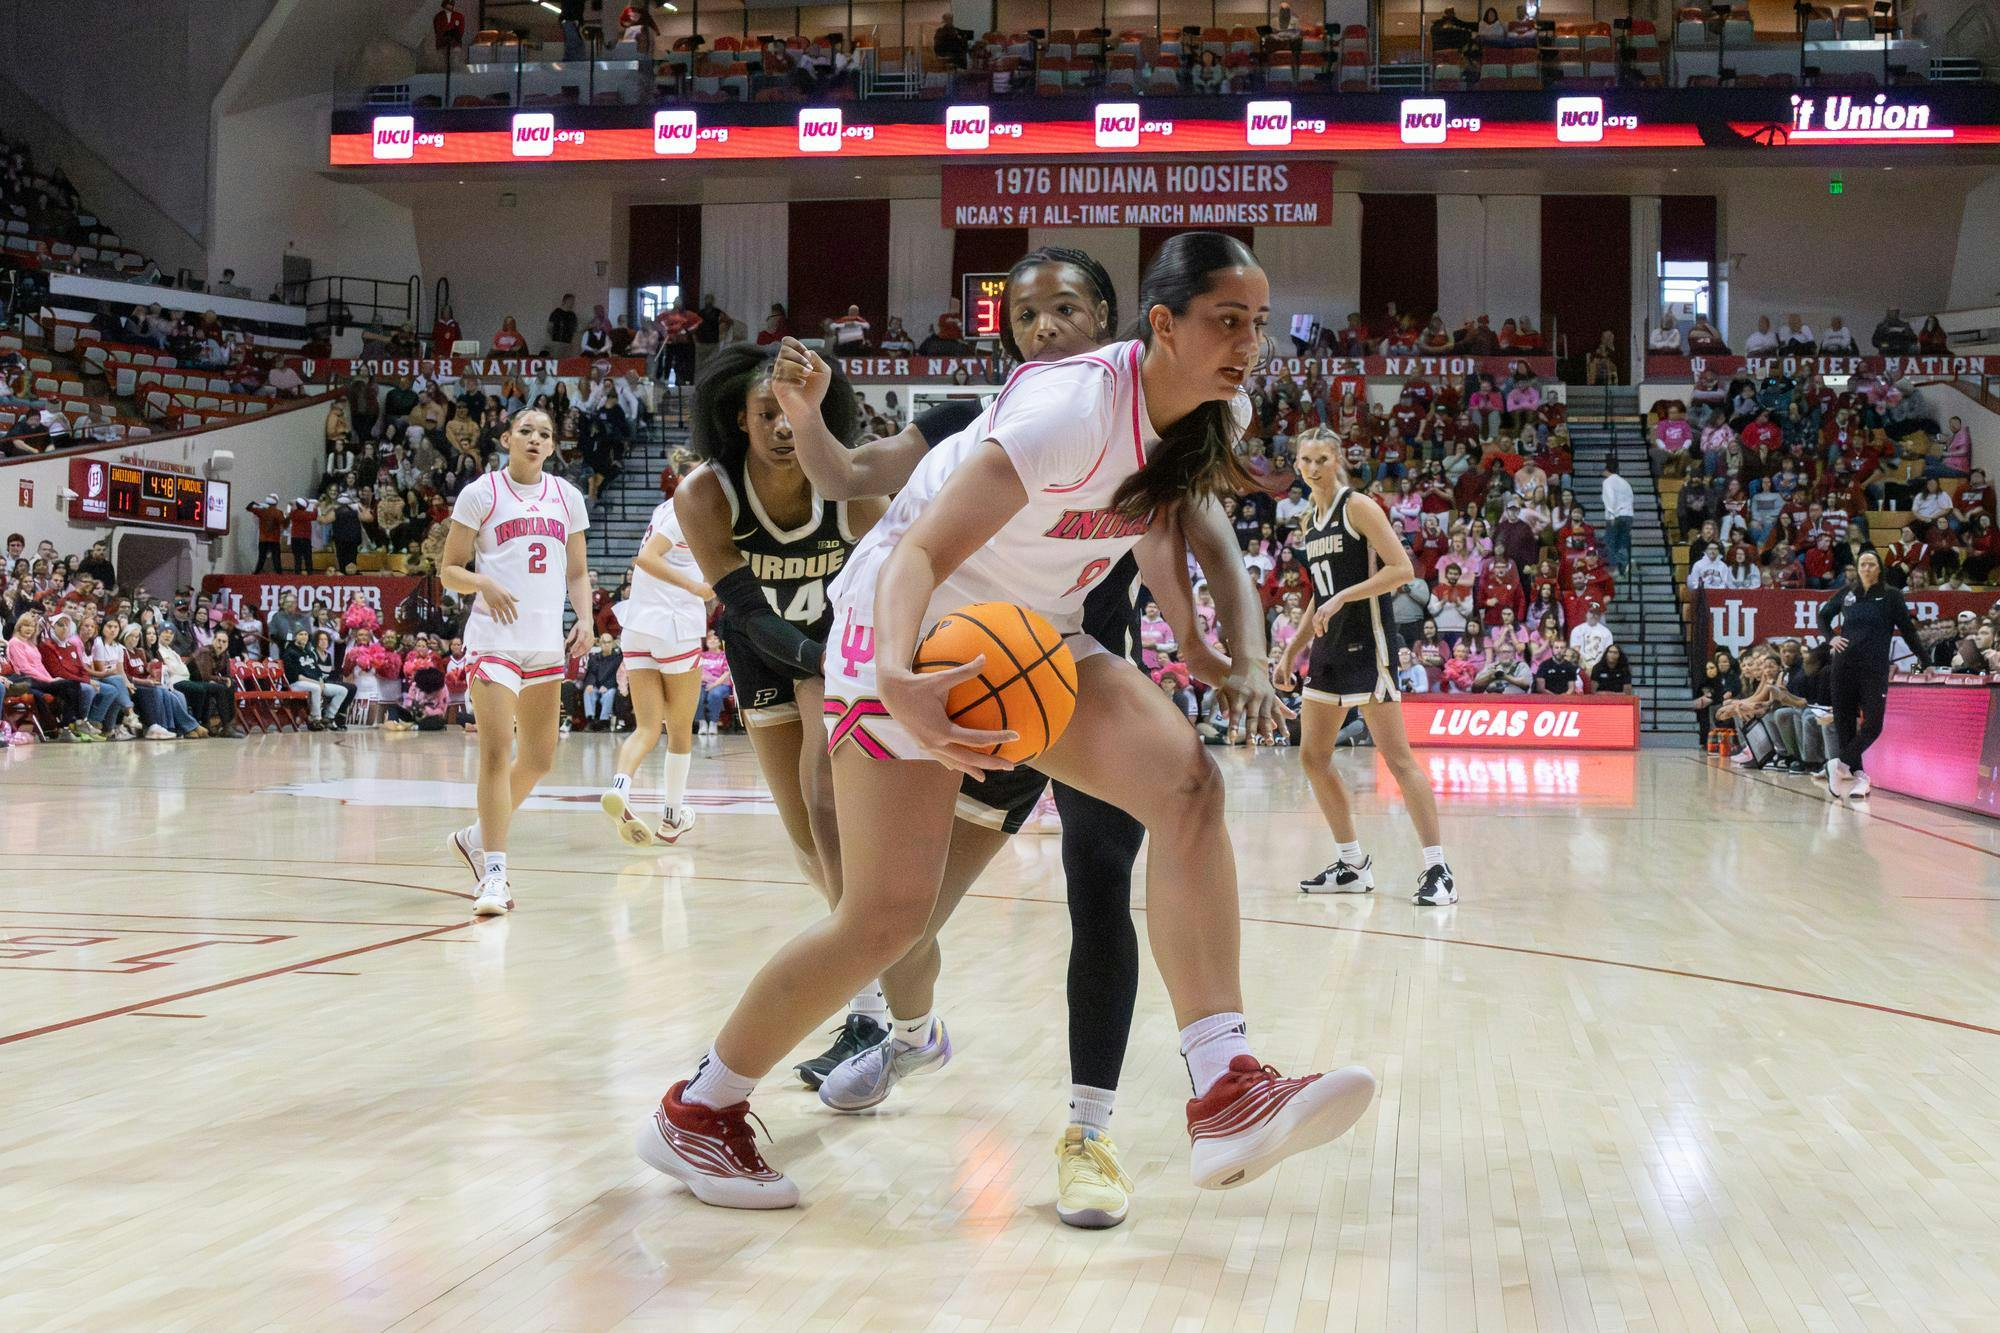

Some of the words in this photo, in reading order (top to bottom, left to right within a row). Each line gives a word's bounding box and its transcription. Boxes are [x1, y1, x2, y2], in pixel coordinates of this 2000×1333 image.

[1824, 94, 1931, 130] Union
[995, 168, 1050, 194] 1976
[1060, 166, 1158, 193] INDIANA
[1166, 165, 1288, 193] HOOSIERS
[956, 206, 1013, 225] NCAA'S
[1019, 206, 1037, 224] #1
[1043, 205, 1119, 224] ALL-TIME
[1125, 205, 1183, 224] MARCH
[1189, 203, 1268, 223] MADNESS
[1274, 203, 1318, 222] TEAM
[151, 476, 174, 498] 4:48
[528, 543, 547, 573] 2
[1310, 560, 1334, 597] 11
[1429, 709, 1528, 737] LUCAS
[1533, 711, 1580, 737] OIL
